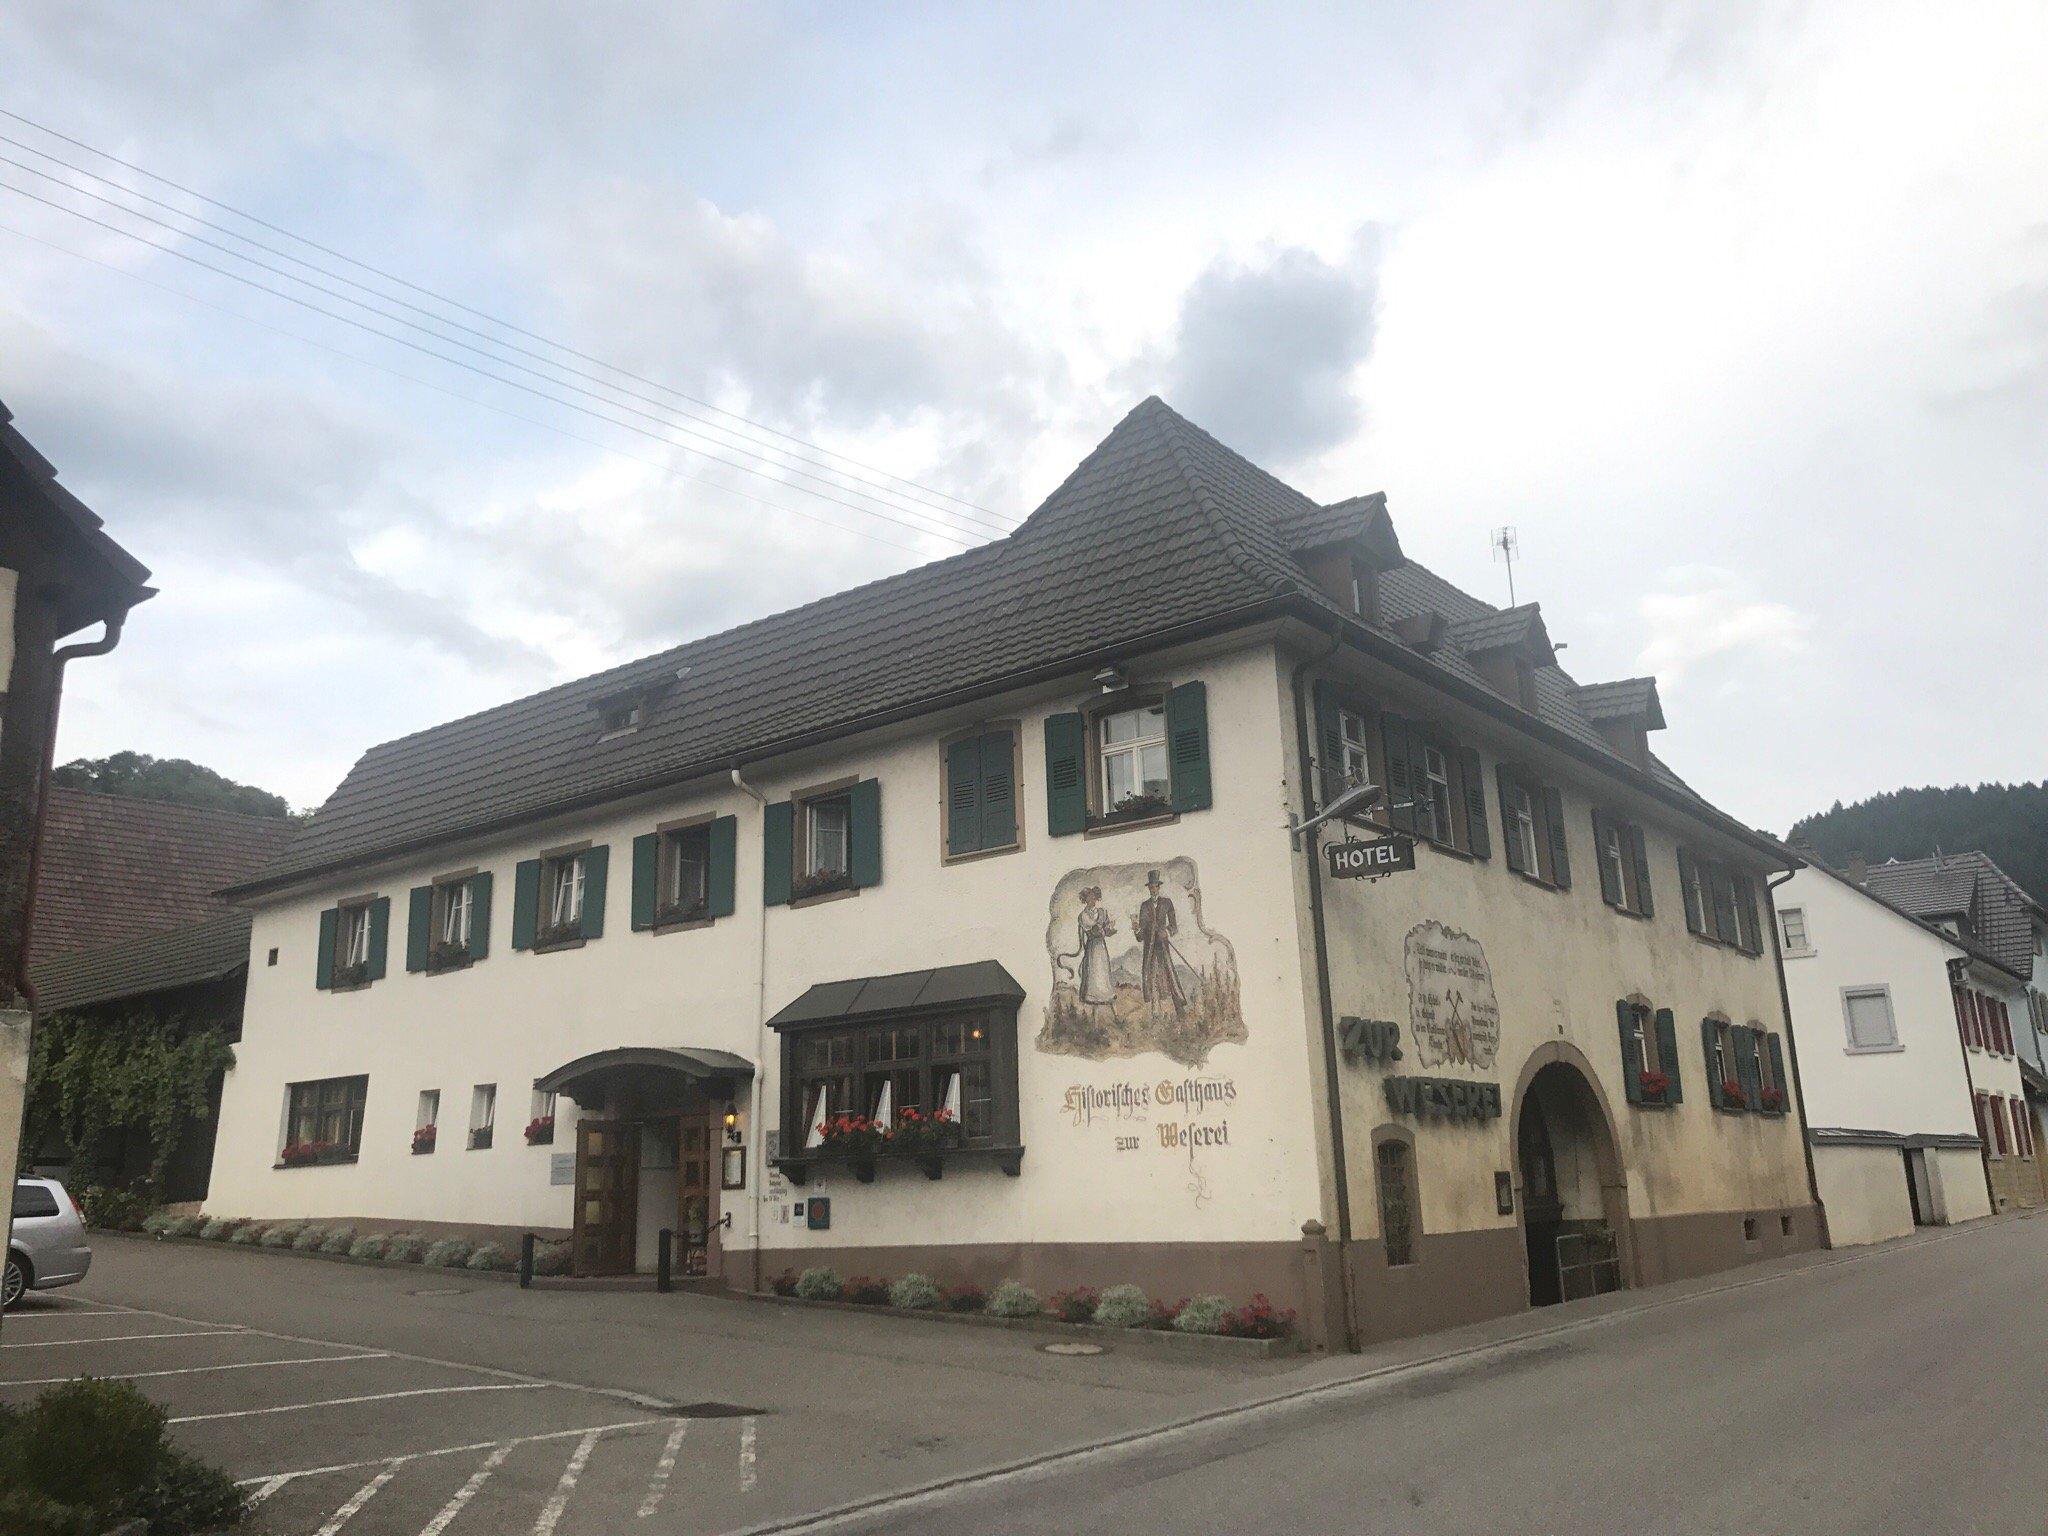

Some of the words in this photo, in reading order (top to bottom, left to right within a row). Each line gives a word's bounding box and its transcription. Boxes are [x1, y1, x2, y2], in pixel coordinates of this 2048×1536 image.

[1335, 844, 1401, 870] HOTEL
[1338, 1016, 1403, 1061] ZUR
[1061, 1082, 1150, 1126] Historisches
[1154, 1078, 1237, 1114] Gasthaus
[1382, 1075, 1502, 1119] WESEREI
[1115, 1136, 1141, 1151] zur
[1157, 1120, 1231, 1161] Weserei
